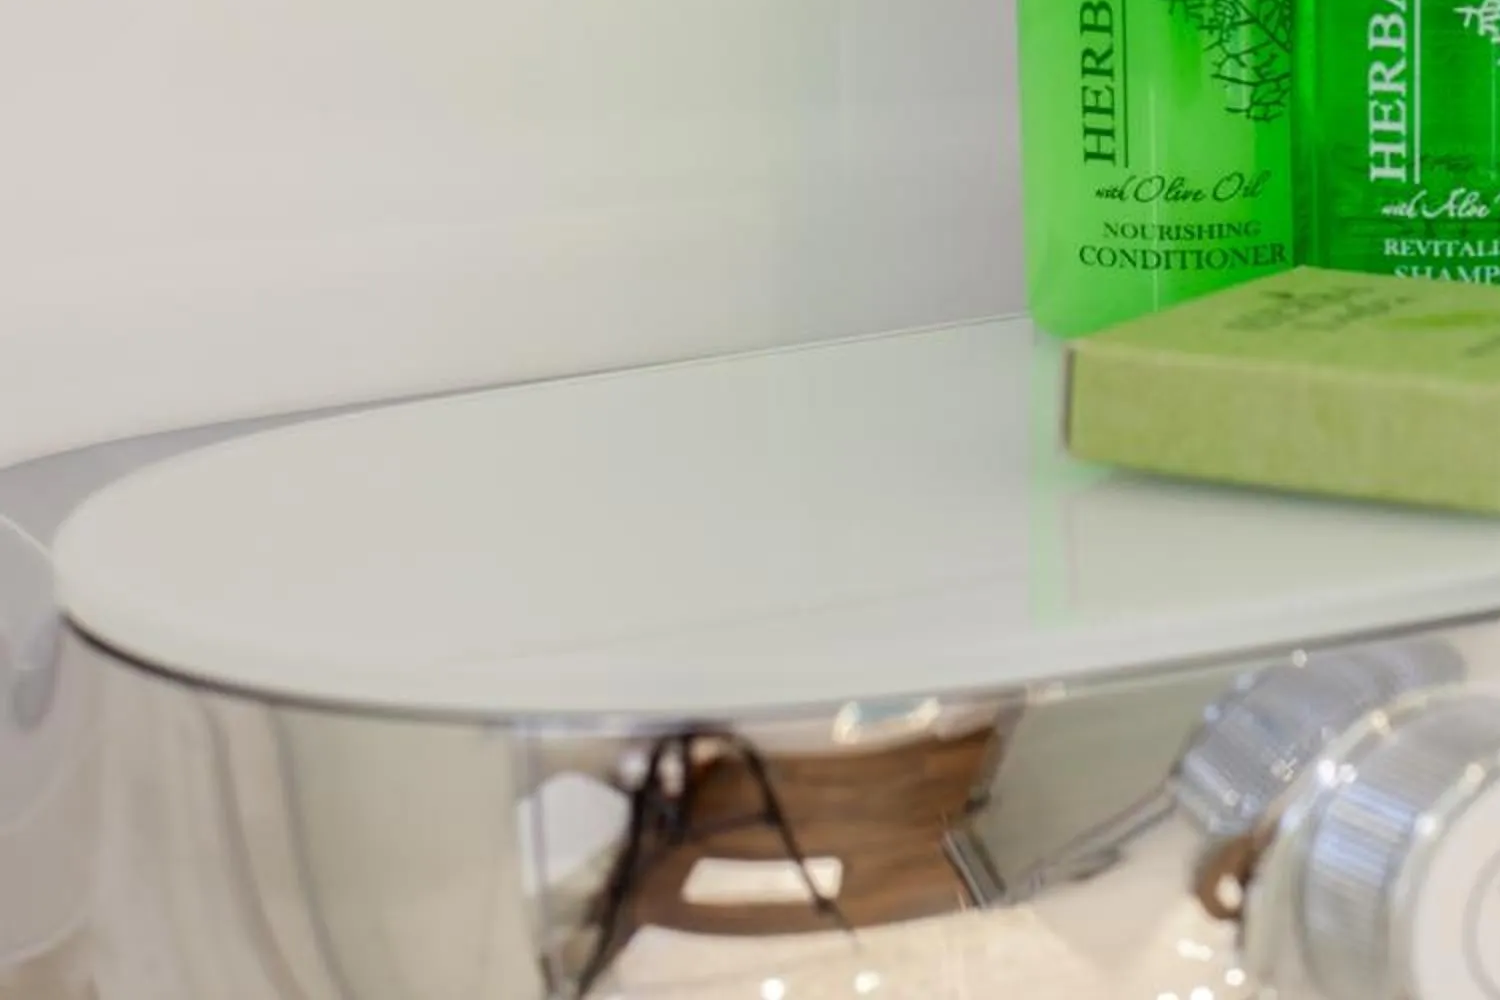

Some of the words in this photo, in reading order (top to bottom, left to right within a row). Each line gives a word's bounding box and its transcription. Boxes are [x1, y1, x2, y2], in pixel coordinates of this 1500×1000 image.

[1134, 175, 1206, 203] Olive
[1212, 170, 1272, 203] Oil
[1421, 188, 1492, 220] Aloe
[1102, 220, 1263, 242] NOURISHING
[1079, 242, 1288, 271] CONDITIONER
